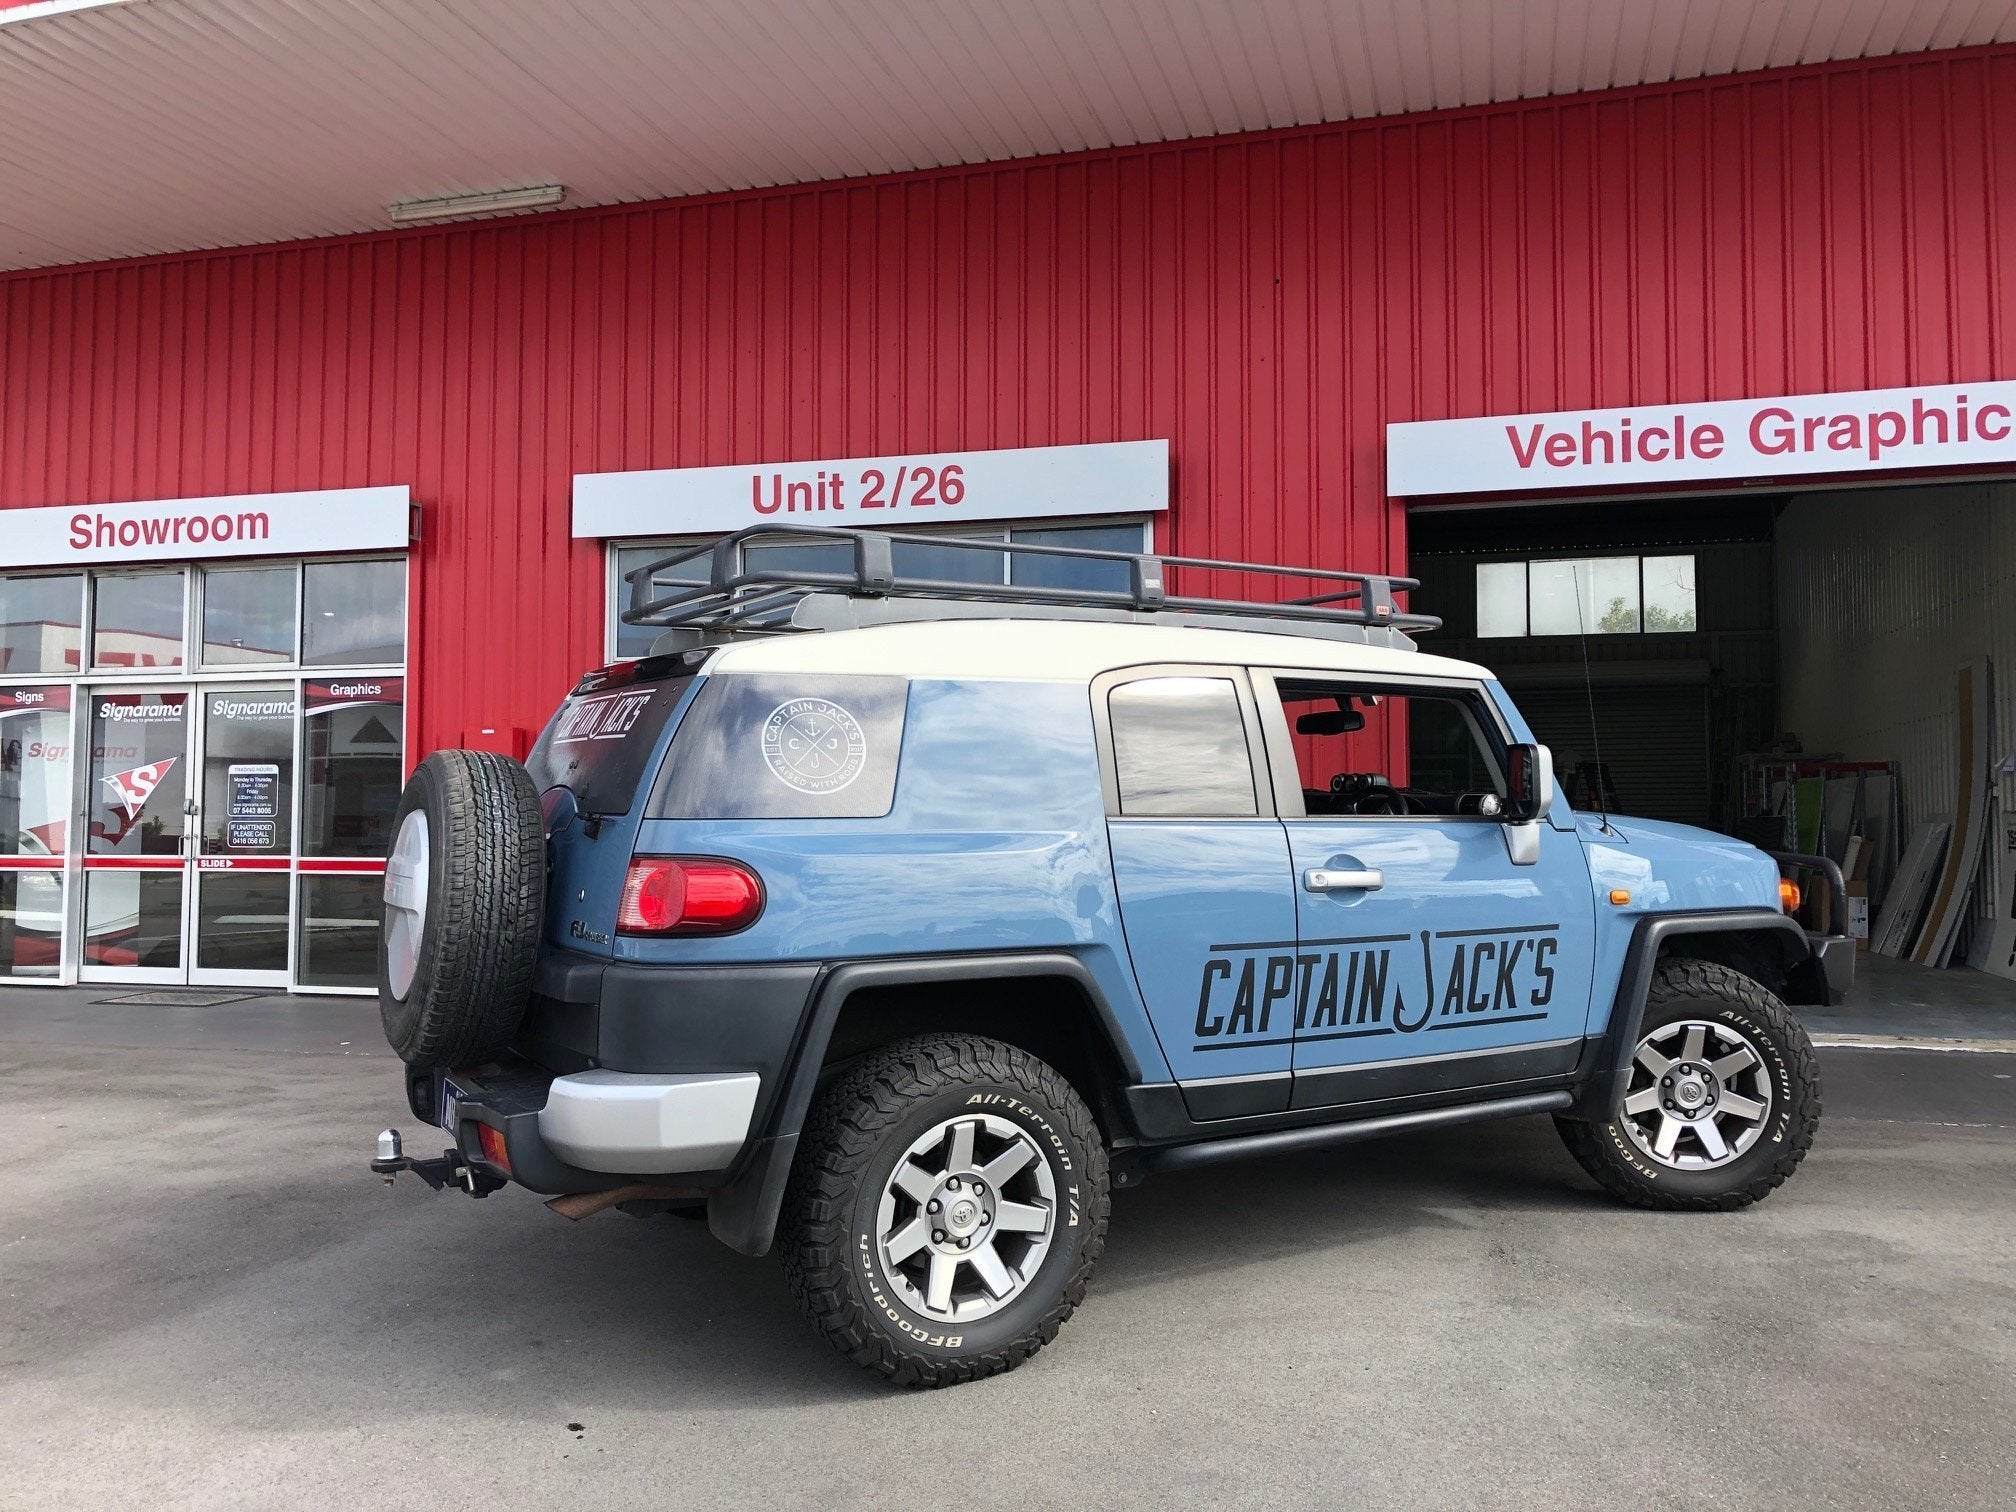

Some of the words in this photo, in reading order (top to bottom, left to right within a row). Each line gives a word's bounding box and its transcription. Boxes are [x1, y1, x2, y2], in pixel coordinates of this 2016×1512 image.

[1505, 414, 1725, 469] Vehicle
[1748, 394, 2011, 462] Graphic
[752, 471, 844, 514] Unit
[860, 465, 965, 508] 2/26
[69, 511, 269, 549] Showroom
[15, 691, 44, 704] Signs
[213, 699, 295, 719] Signarama
[330, 683, 382, 698] Graphics
[99, 702, 183, 721] Signarama
[766, 702, 813, 742] CAPTAIN
[817, 703, 860, 741] JACK'S
[788, 738, 799, 750] C
[827, 738, 838, 750] J
[773, 759, 807, 786] RAISED
[810, 778, 838, 788] WITH
[839, 759, 858, 780] RODS
[1195, 949, 1391, 1038] CAPTAIN
[1392, 930, 1558, 1033] JACK'S
[1719, 1010, 1792, 1101] All-Terrain
[1772, 1112, 1791, 1143] T/A
[965, 1093, 1073, 1171] All-Terrain
[1067, 1184, 1080, 1227] T/A
[859, 1234, 963, 1348] BFGoodrich
